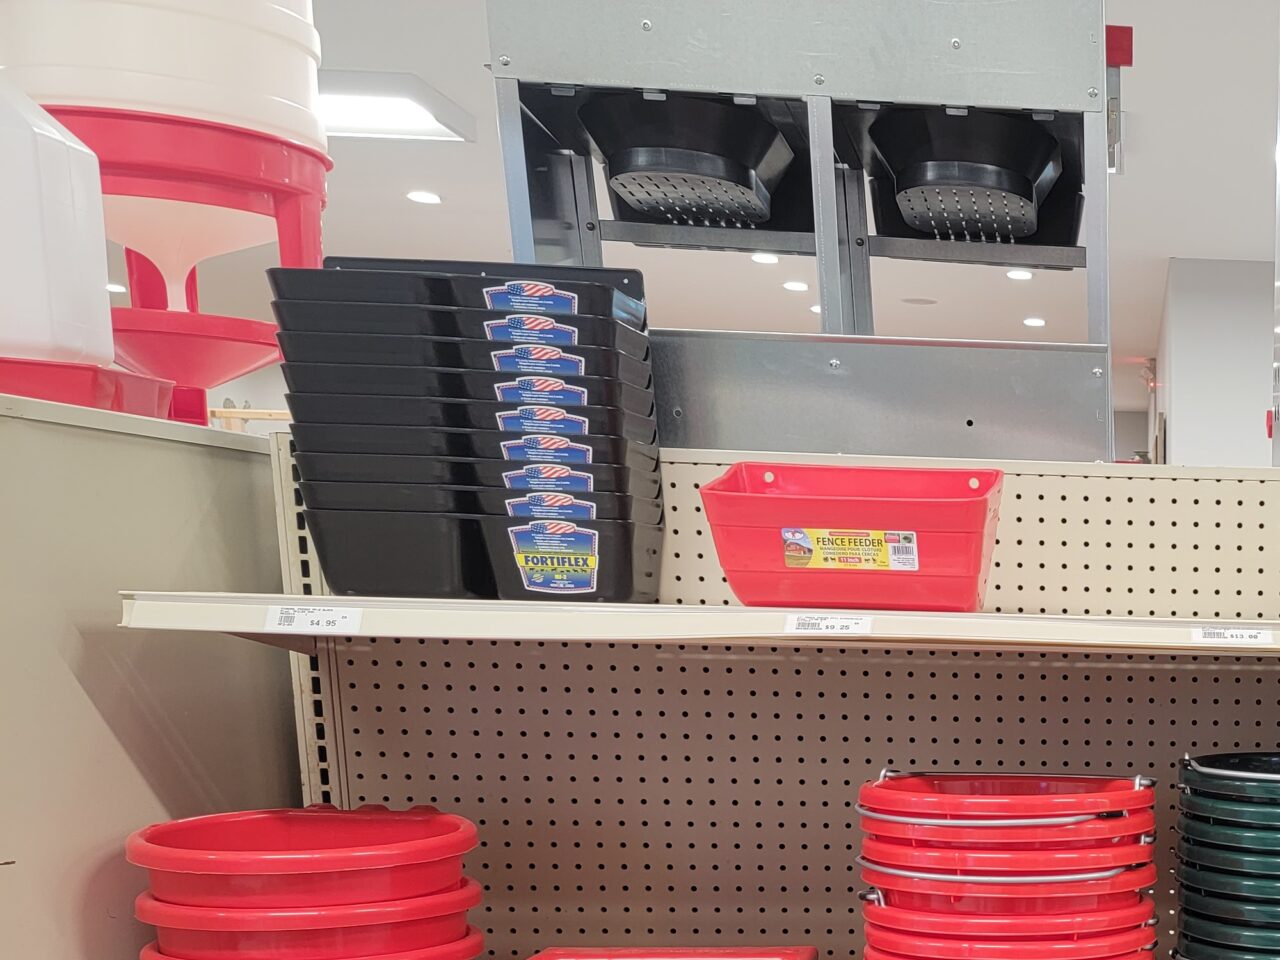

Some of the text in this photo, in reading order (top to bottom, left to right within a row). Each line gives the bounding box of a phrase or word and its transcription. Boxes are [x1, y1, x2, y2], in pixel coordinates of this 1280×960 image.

[816, 537, 884, 547] FENCE FEEDER
[523, 555, 589, 567] FORTIFLEX
[309, 619, 337, 627] $4.95
